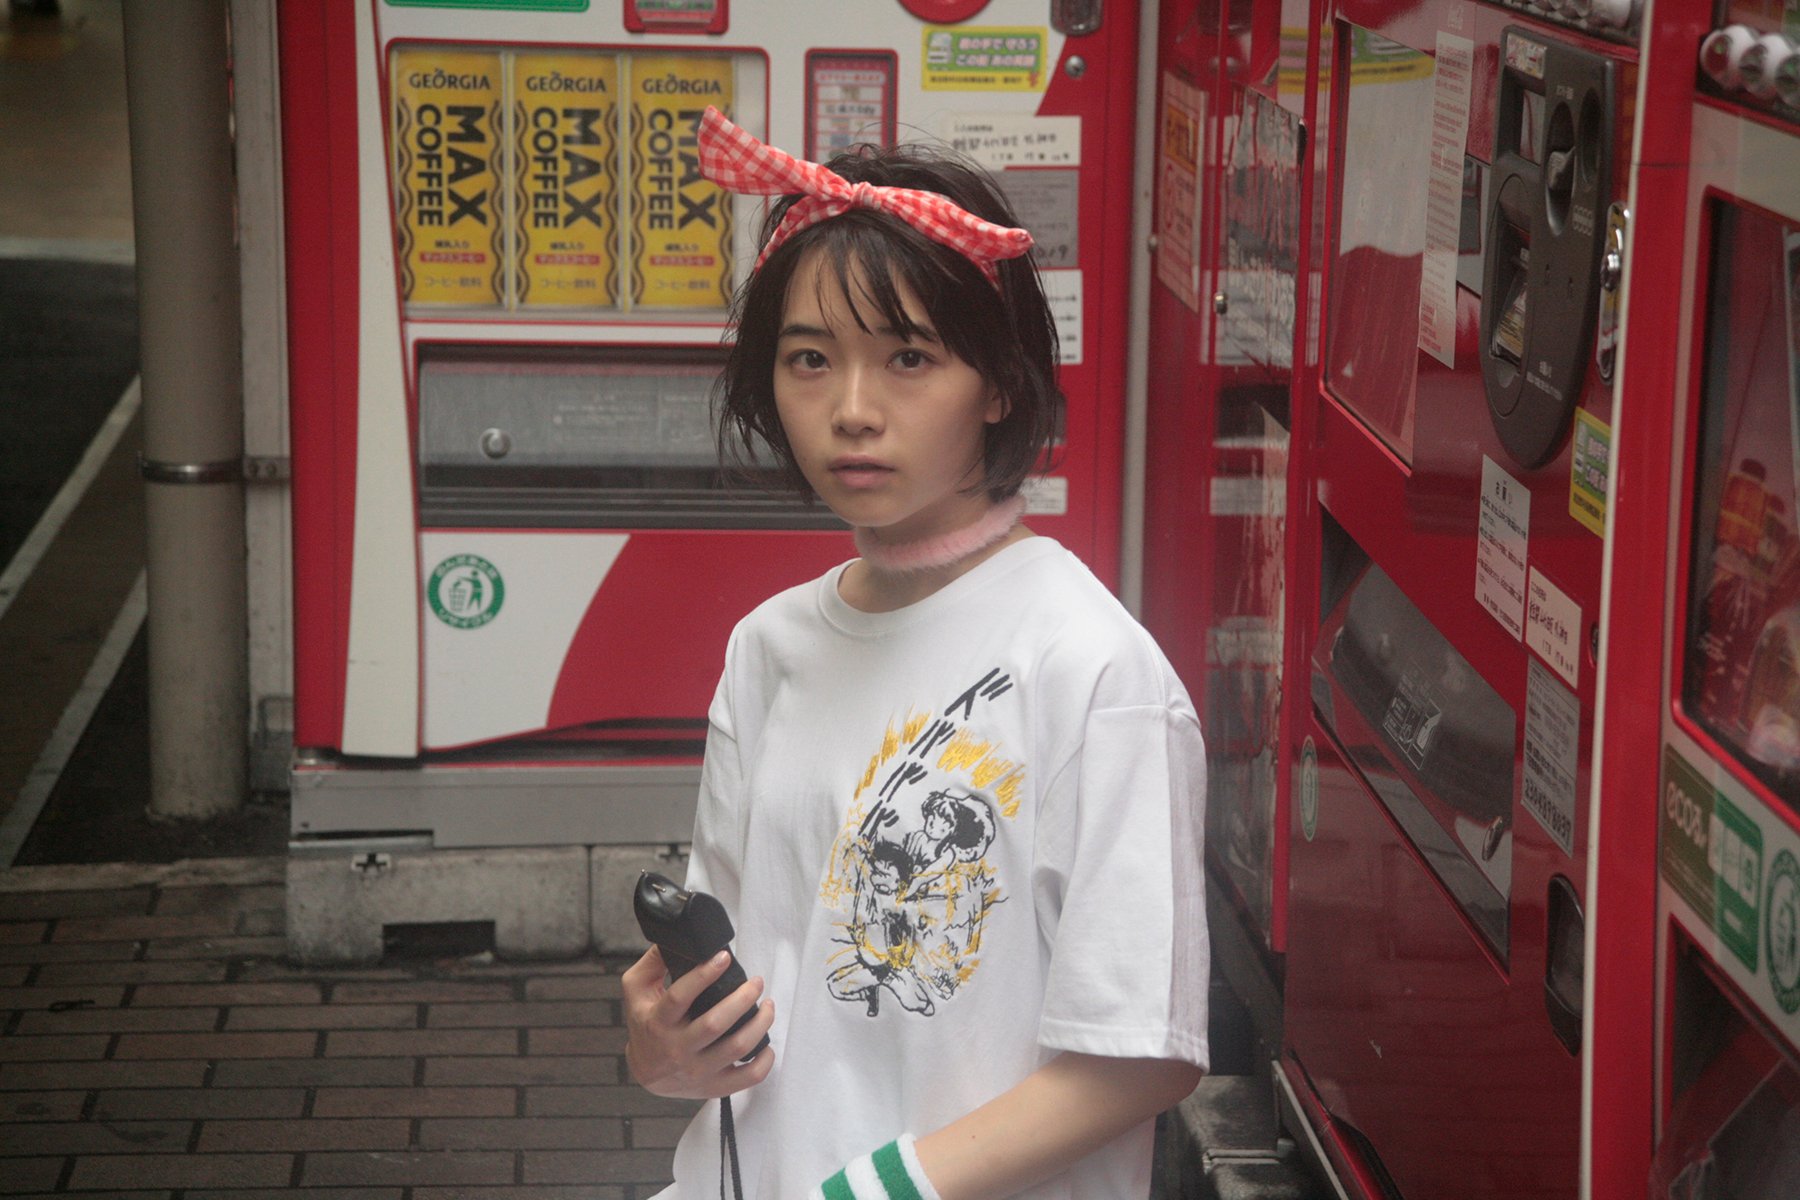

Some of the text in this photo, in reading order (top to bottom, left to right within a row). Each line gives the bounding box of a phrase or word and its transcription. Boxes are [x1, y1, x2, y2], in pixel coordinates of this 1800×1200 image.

[409, 68, 490, 90] GEORGIA
[526, 71, 607, 93] GEORGIA
[642, 73, 722, 95] GEORGIA
[416, 104, 443, 226] COFFEE
[447, 106, 487, 226] MAX
[532, 107, 558, 228] COFFEE
[563, 108, 602, 228] MAX
[647, 109, 673, 229] COFFEE
